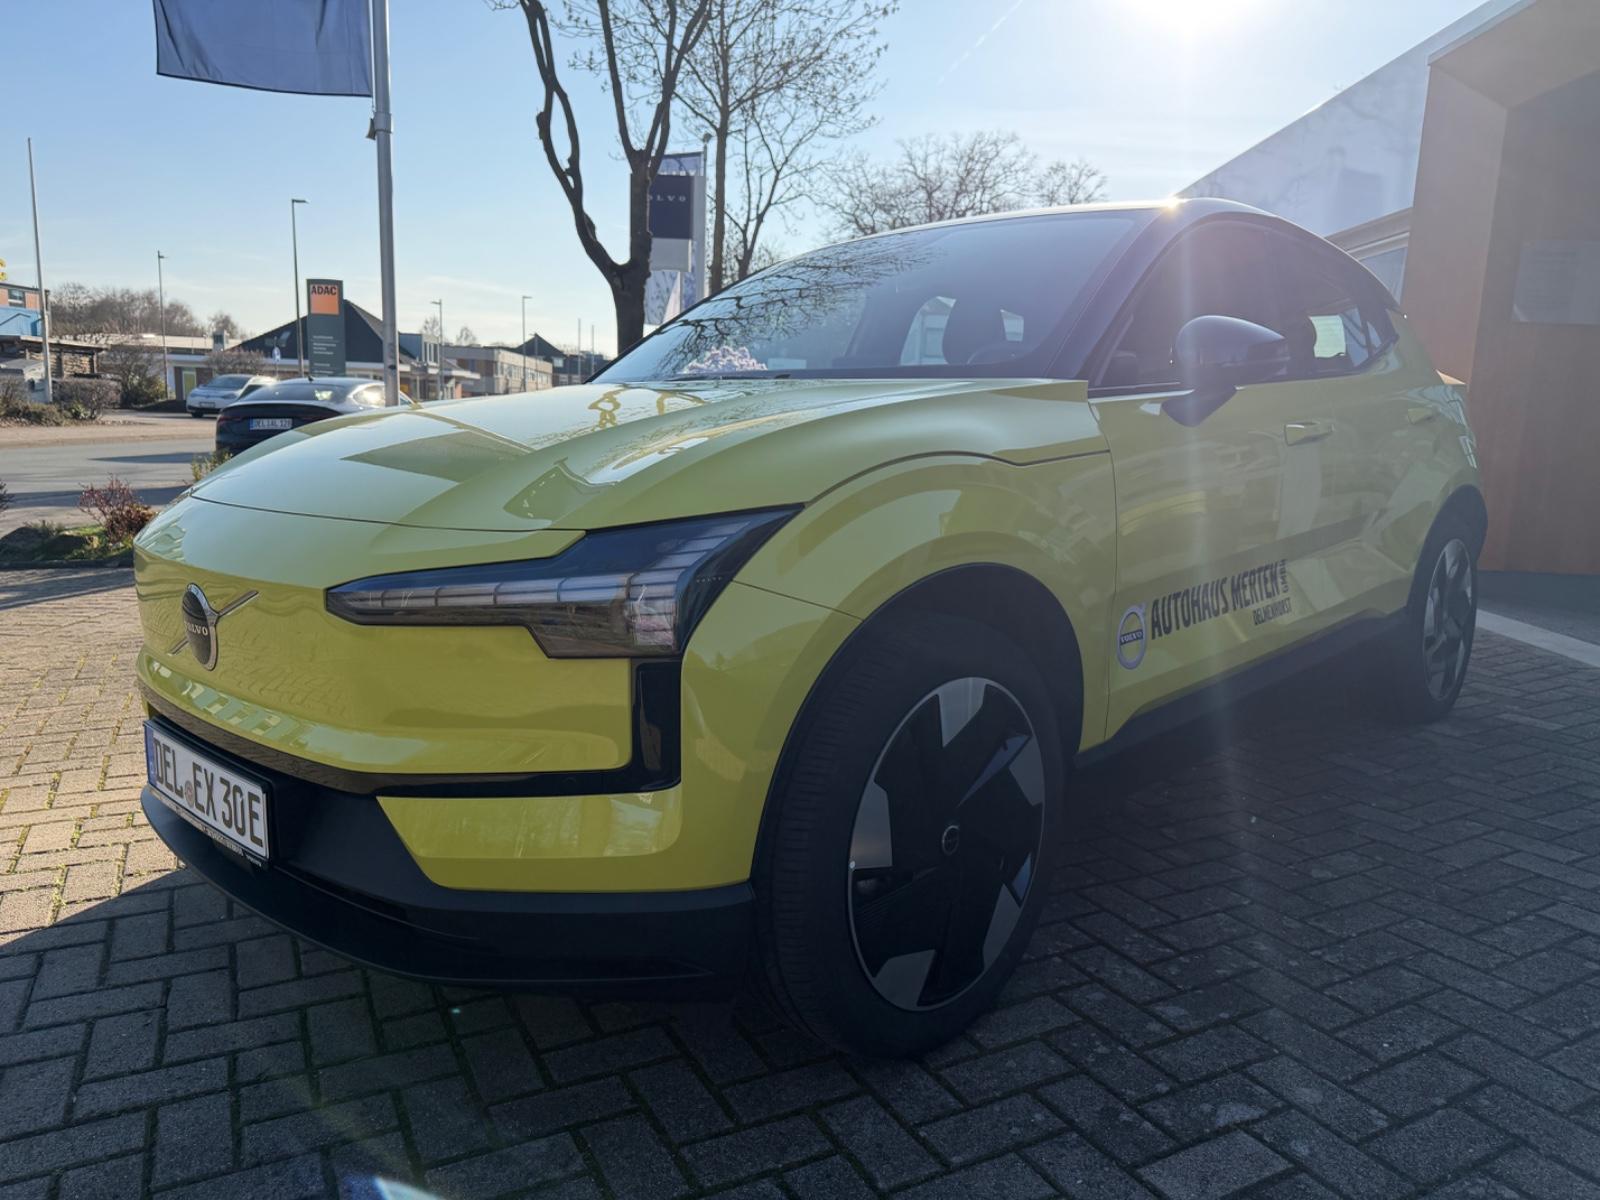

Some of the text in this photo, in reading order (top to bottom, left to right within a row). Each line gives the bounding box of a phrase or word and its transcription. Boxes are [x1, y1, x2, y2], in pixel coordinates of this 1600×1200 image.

[311, 285, 337, 296] ADAC
[1151, 562, 1281, 641] AUTOHAUS MERTEN
[153, 737, 184, 799] DEL
[192, 761, 217, 821] EX
[219, 776, 264, 848] 30E
